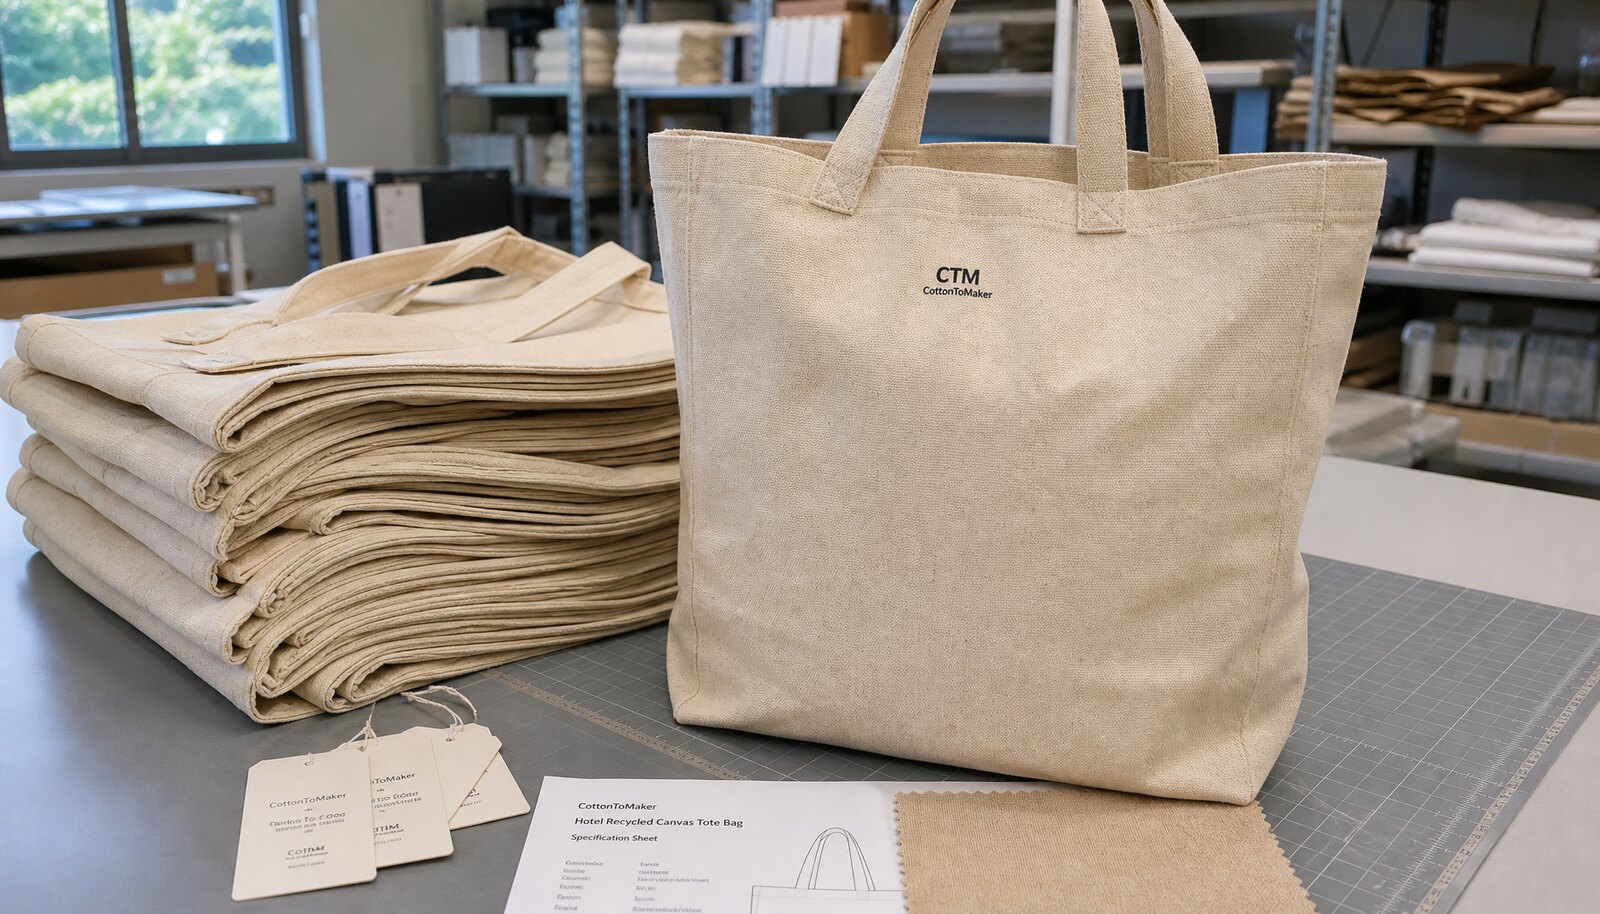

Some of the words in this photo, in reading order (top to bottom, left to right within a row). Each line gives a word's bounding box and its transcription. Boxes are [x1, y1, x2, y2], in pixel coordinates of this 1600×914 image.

[936, 266, 980, 285] CTM
[923, 286, 993, 299] CottonToMaker
[269, 793, 347, 809] CottonToMaker
[578, 802, 657, 811] CottonToMaker
[574, 817, 604, 826] Hotel
[606, 817, 654, 827] Recycled
[656, 818, 694, 827] Canvas
[697, 818, 721, 827] Tote
[723, 819, 744, 829] Bag
[571, 833, 630, 842] Specification
[632, 834, 658, 842] Sheet
